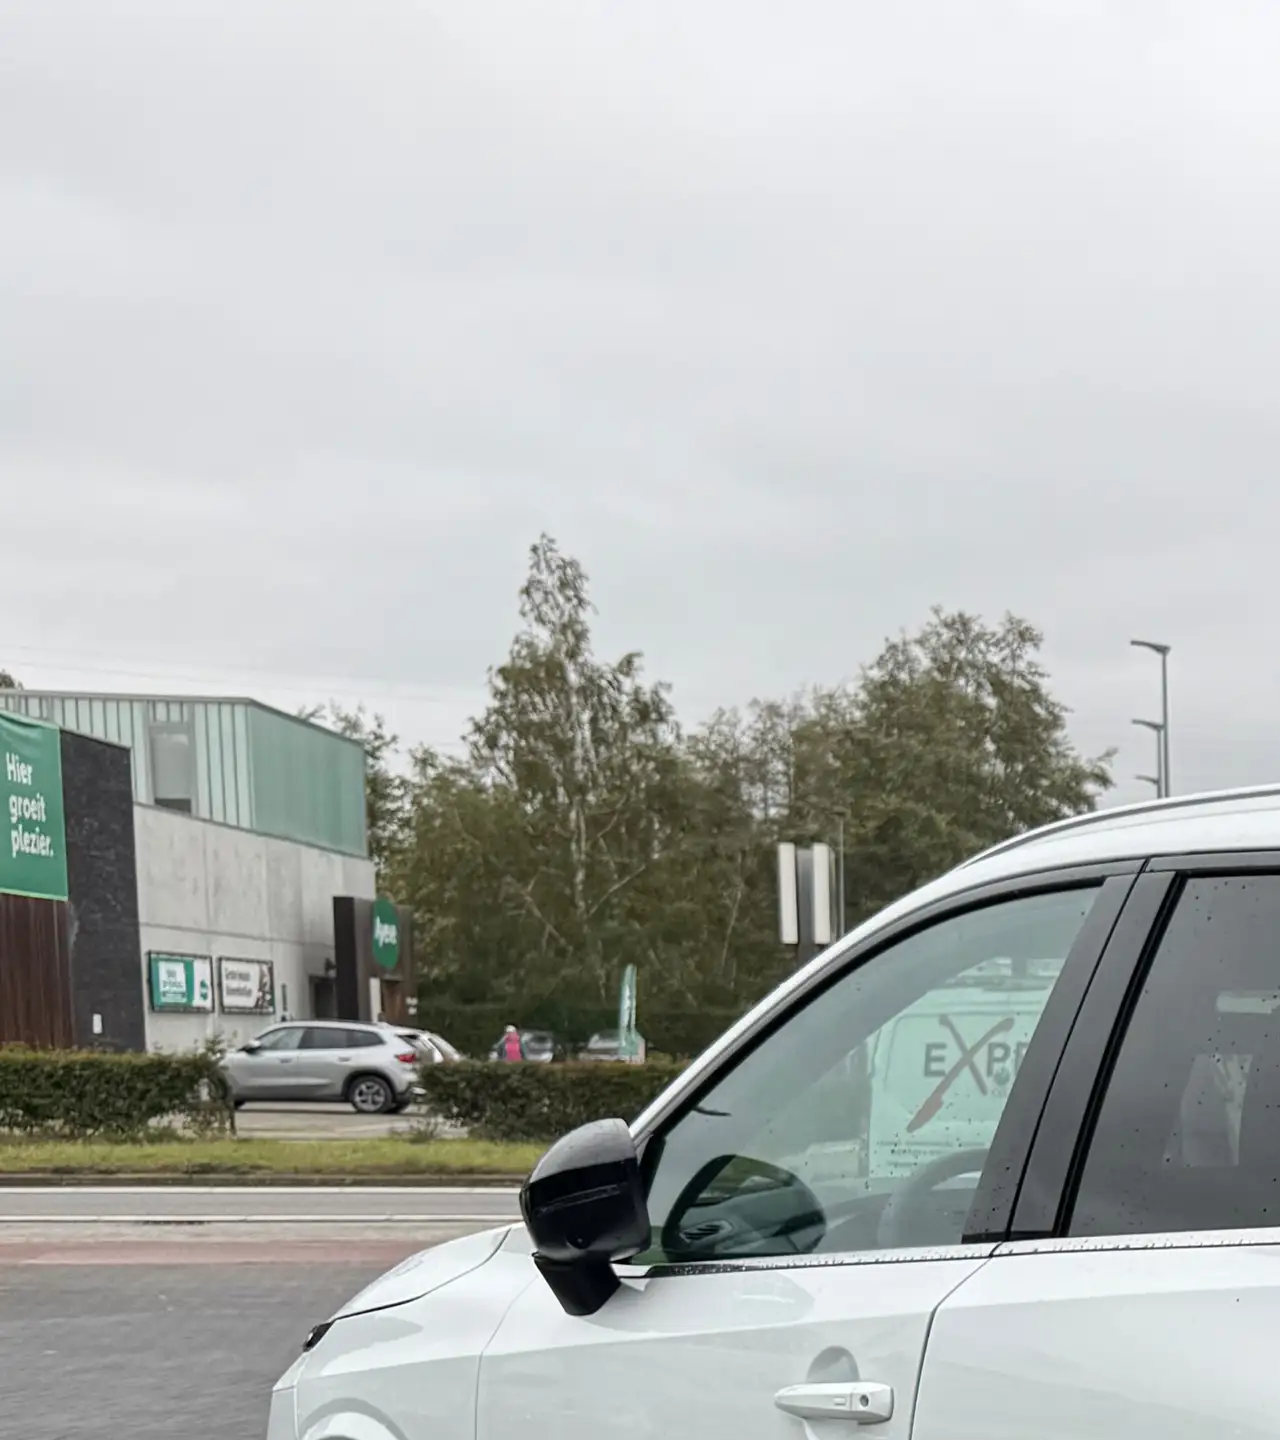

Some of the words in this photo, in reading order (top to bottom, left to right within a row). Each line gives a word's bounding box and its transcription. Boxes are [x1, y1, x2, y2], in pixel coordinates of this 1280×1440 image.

[6, 752, 32, 785] Hier
[9, 792, 46, 823] groeit
[11, 823, 54, 858] plezier.
